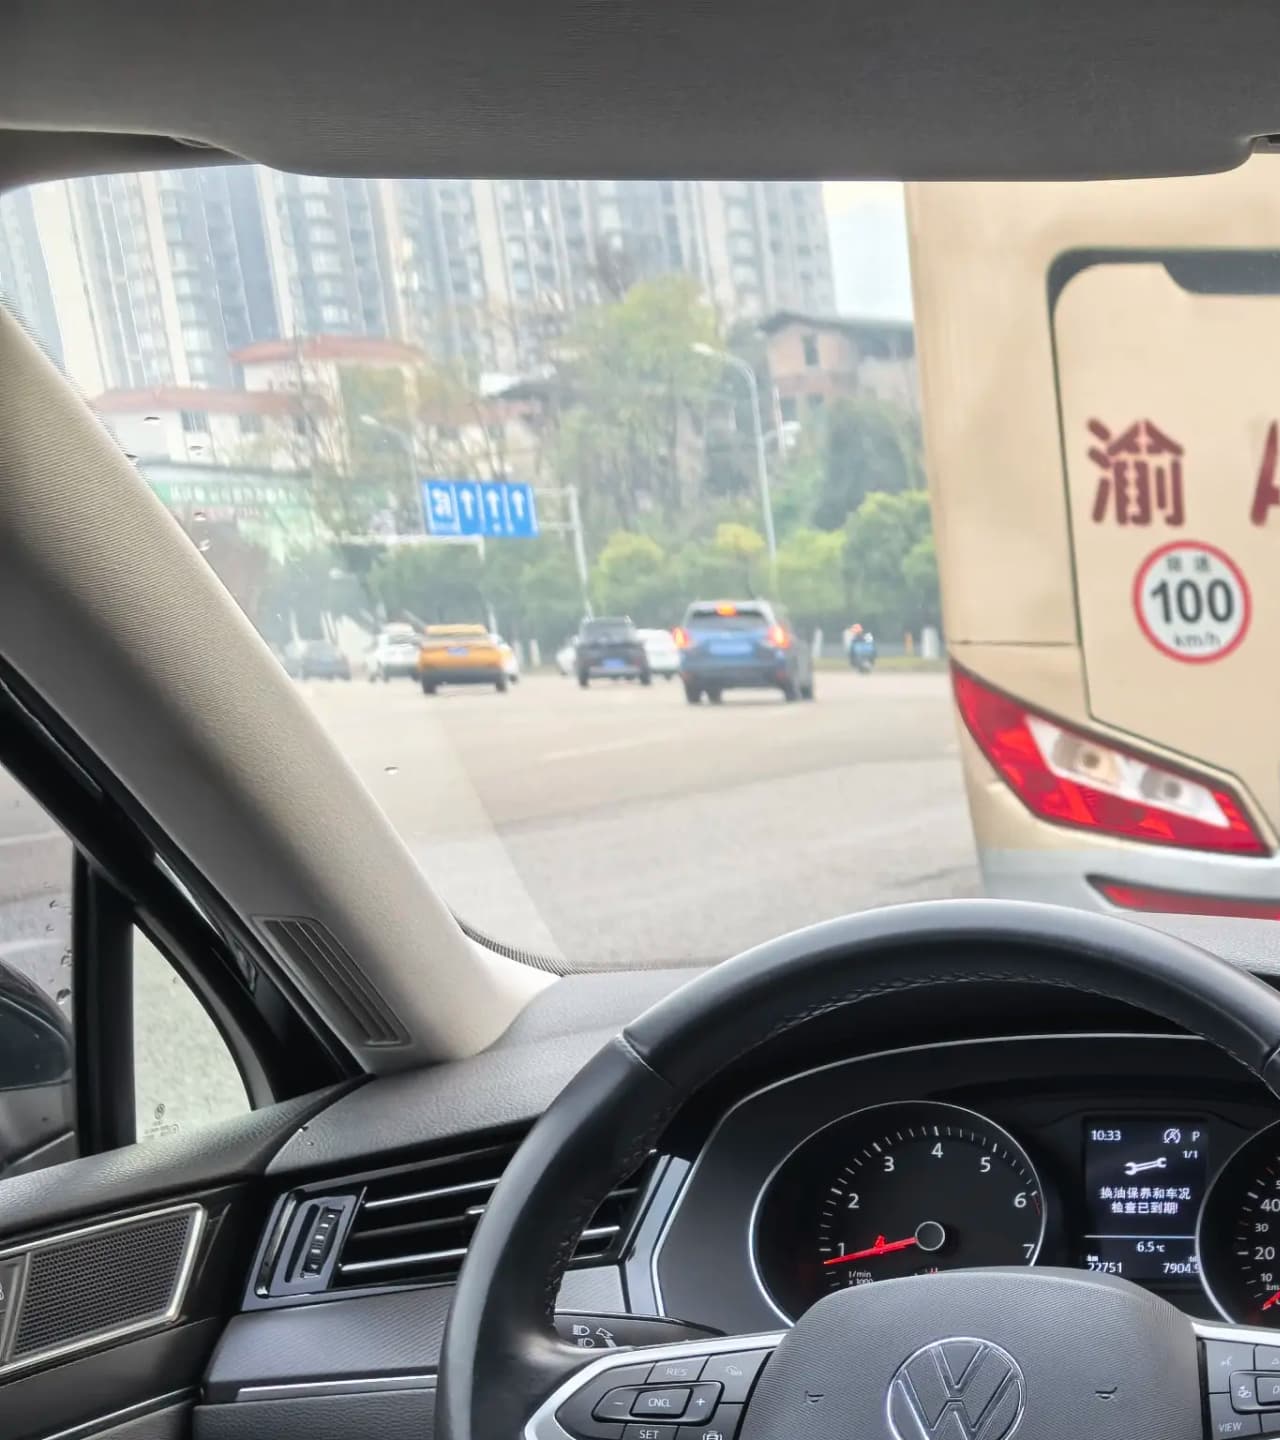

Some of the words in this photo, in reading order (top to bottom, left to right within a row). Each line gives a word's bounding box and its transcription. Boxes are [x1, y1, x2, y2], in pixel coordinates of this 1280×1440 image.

[1150, 578, 1235, 624] 100
[1091, 1129, 1121, 1141] 10:33
[931, 1142, 944, 1159] 4
[883, 1156, 895, 1172] 3
[979, 1156, 992, 1173] 5
[847, 1193, 860, 1209] 2
[1014, 1191, 1027, 1208] 6
[1255, 1223, 1269, 1233] 30
[837, 1242, 846, 1257] 1
[1022, 1243, 1036, 1260] 7
[1253, 1246, 1276, 1260] 20
[1260, 1273, 1273, 1282] 10
[665, 1367, 688, 1376] RES
[648, 1398, 672, 1408] CNCL
[1218, 1421, 1243, 1433] VIEW
[639, 1430, 660, 1440] SET
